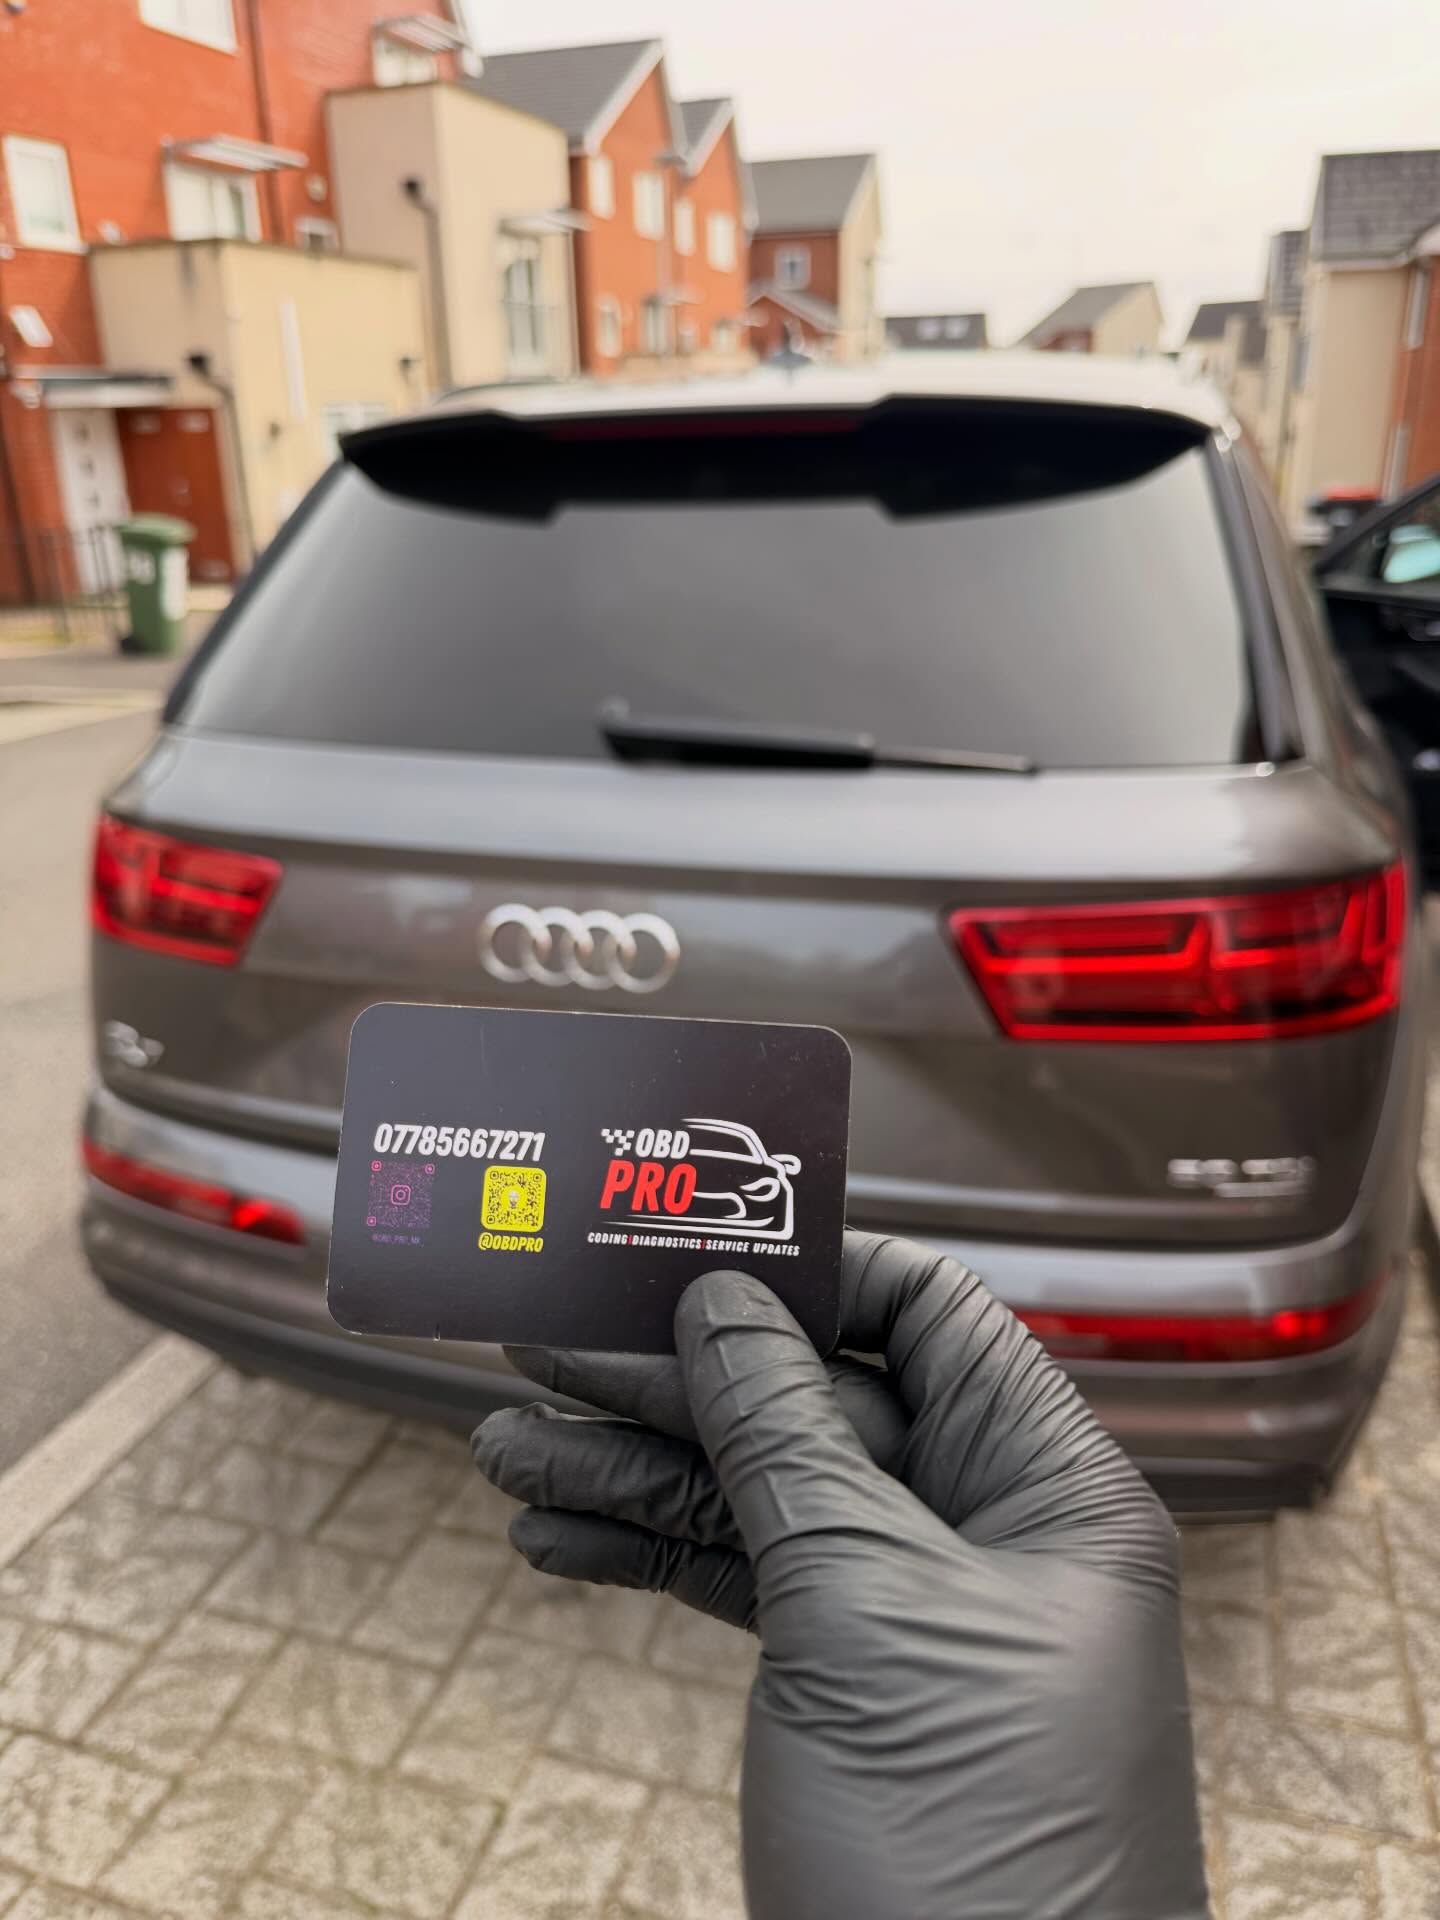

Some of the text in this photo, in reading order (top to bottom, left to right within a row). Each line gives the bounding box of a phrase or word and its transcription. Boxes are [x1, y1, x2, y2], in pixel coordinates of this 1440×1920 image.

[374, 1123, 546, 1162] 07785667271
[635, 1128, 690, 1159] OBD
[600, 1160, 696, 1214] PRO
[478, 1232, 544, 1253] @OBDPRO
[752, 1242, 800, 1257] UPDATES
